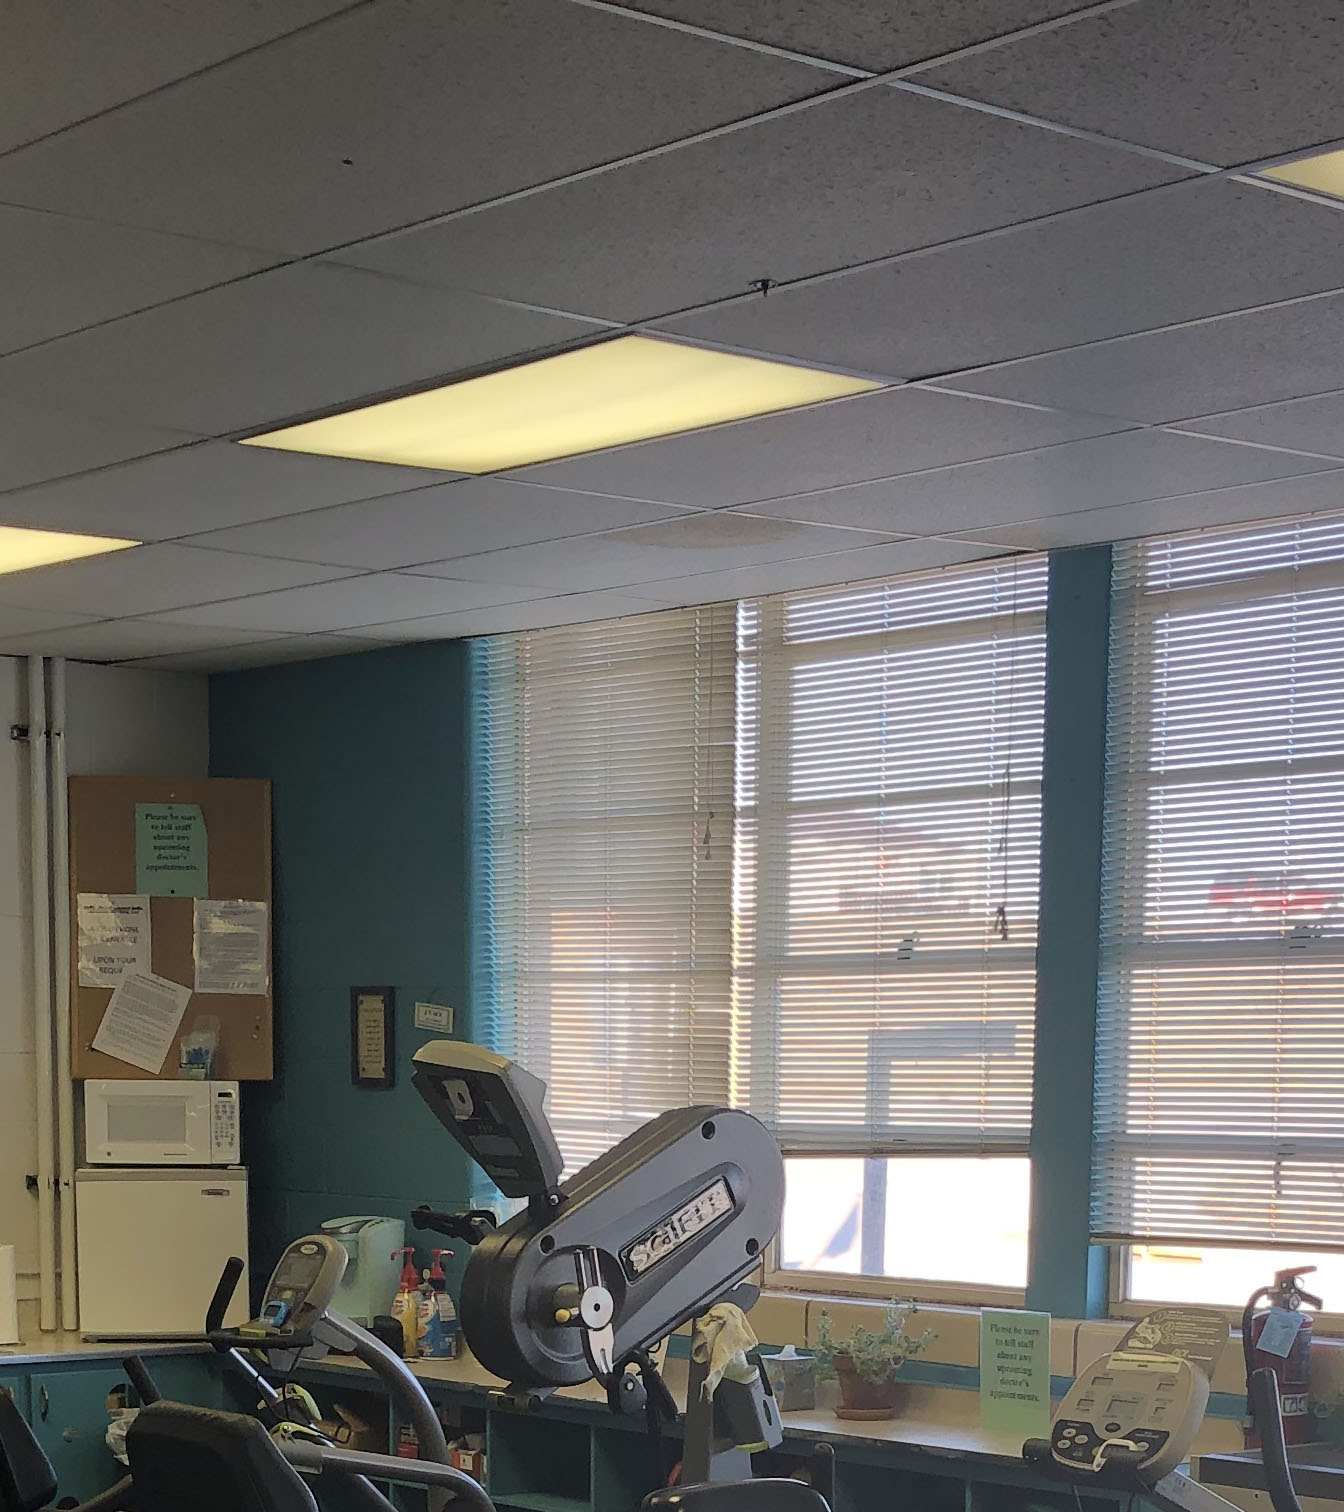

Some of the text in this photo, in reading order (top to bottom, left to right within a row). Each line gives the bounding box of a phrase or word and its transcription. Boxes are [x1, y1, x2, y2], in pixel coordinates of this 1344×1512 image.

[990, 1323, 1012, 1334] Please
[1004, 1338, 1016, 1347] tell
[1017, 1339, 1034, 1348] staff
[997, 1351, 1017, 1360] about
